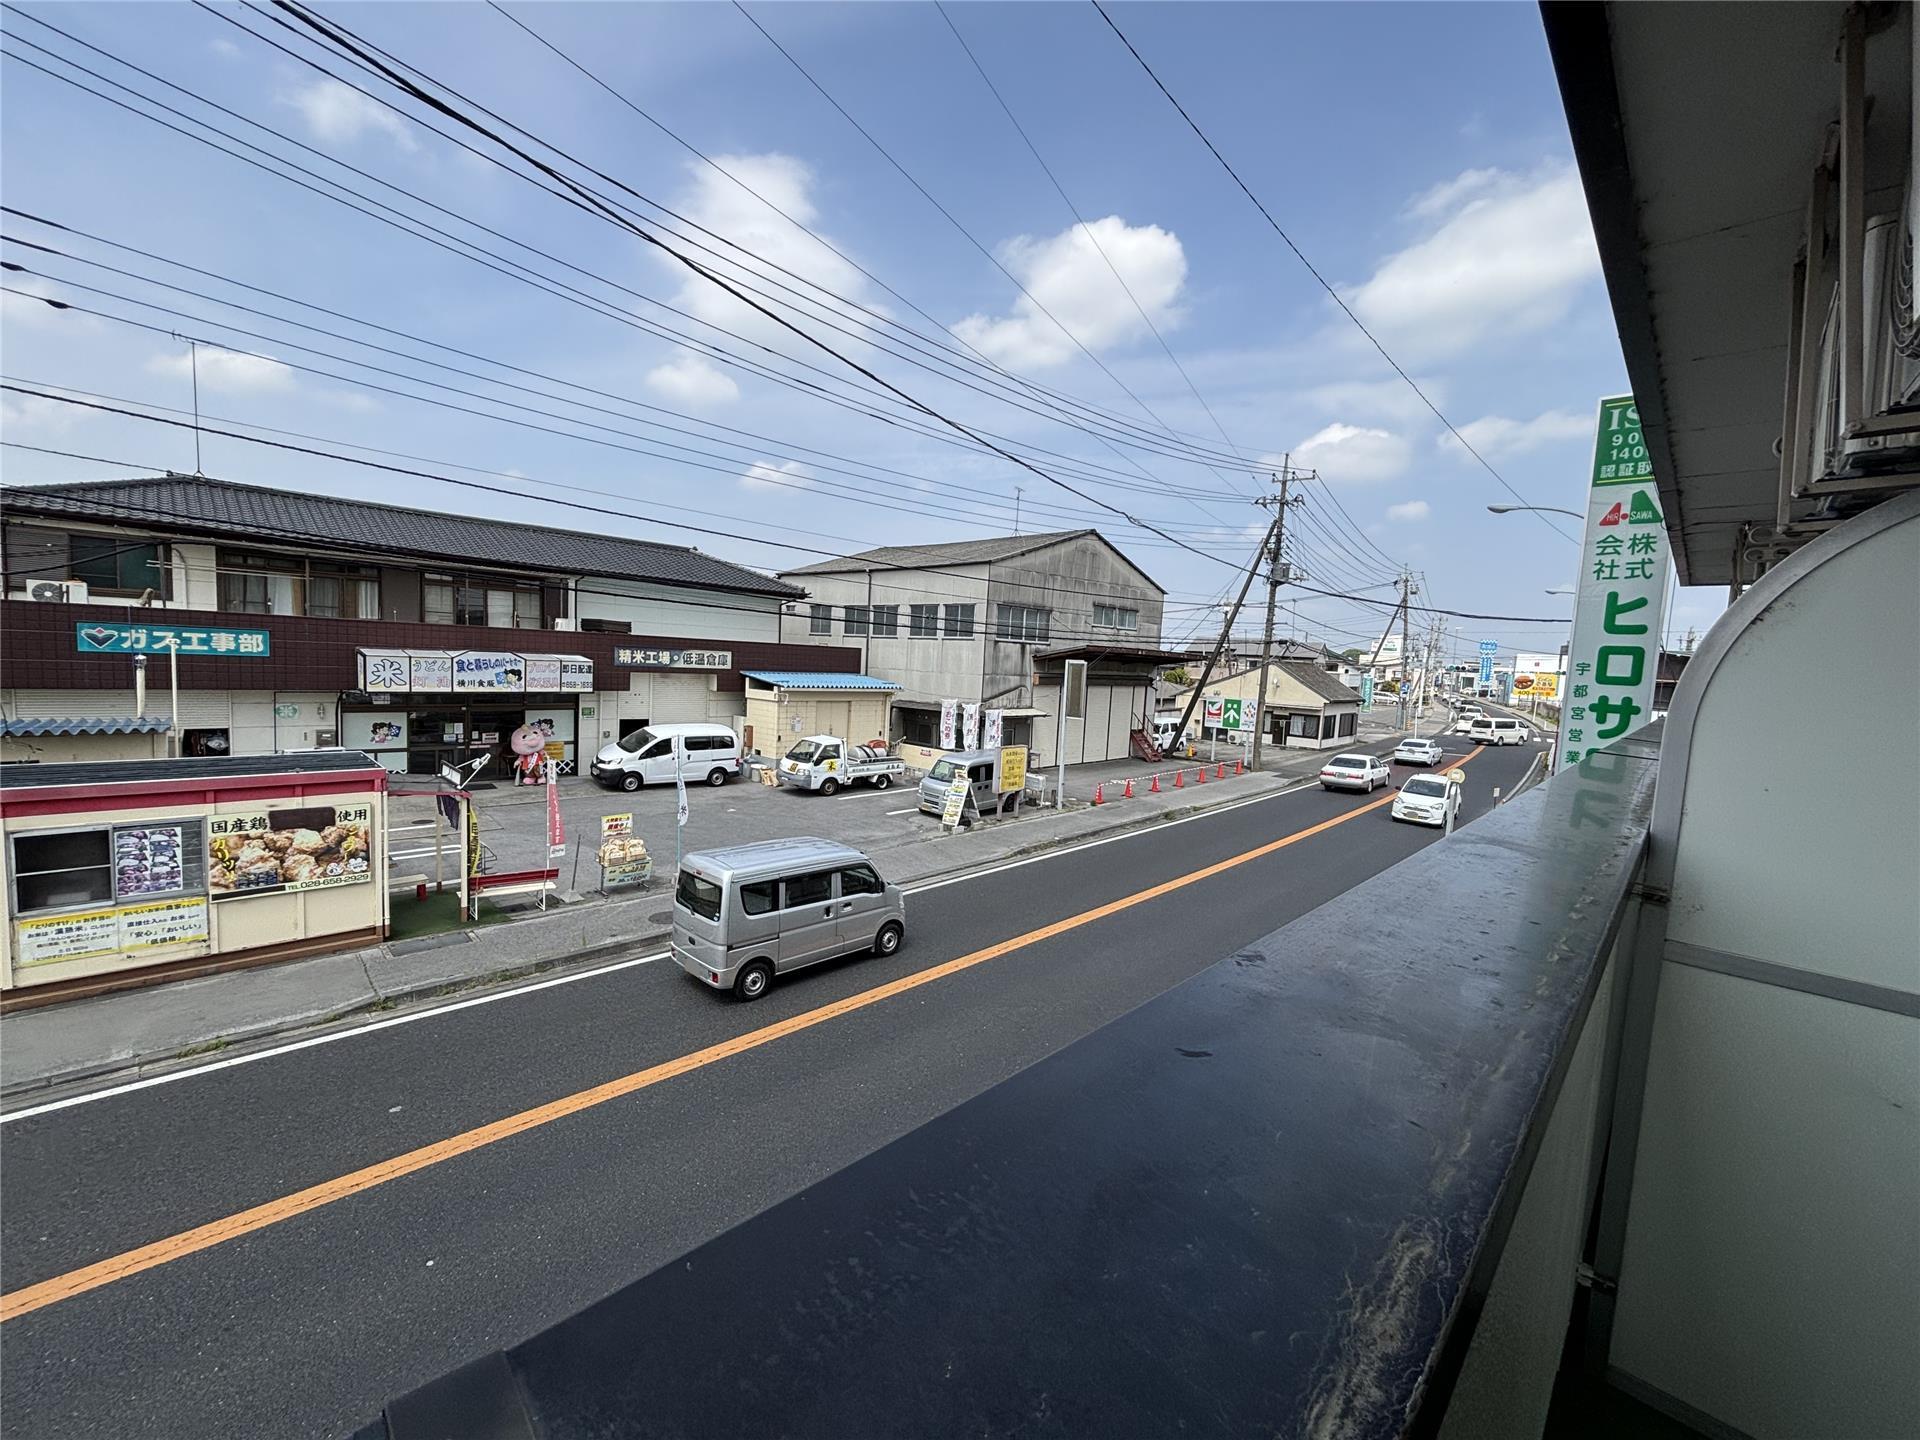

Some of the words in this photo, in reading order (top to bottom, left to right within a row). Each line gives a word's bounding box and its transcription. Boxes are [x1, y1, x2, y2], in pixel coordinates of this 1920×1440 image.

[1610, 446, 1649, 460] 140
[120, 628, 264, 653] ガス工事部
[368, 658, 408, 689] 米
[412, 659, 451, 673] うどん
[562, 664, 593, 674] 即日配達
[1586, 591, 1649, 757] ヒロサ
[1565, 662, 1592, 764] 宇都宮営業
[211, 815, 269, 835] 国産鶏
[337, 808, 368, 823] 使用
